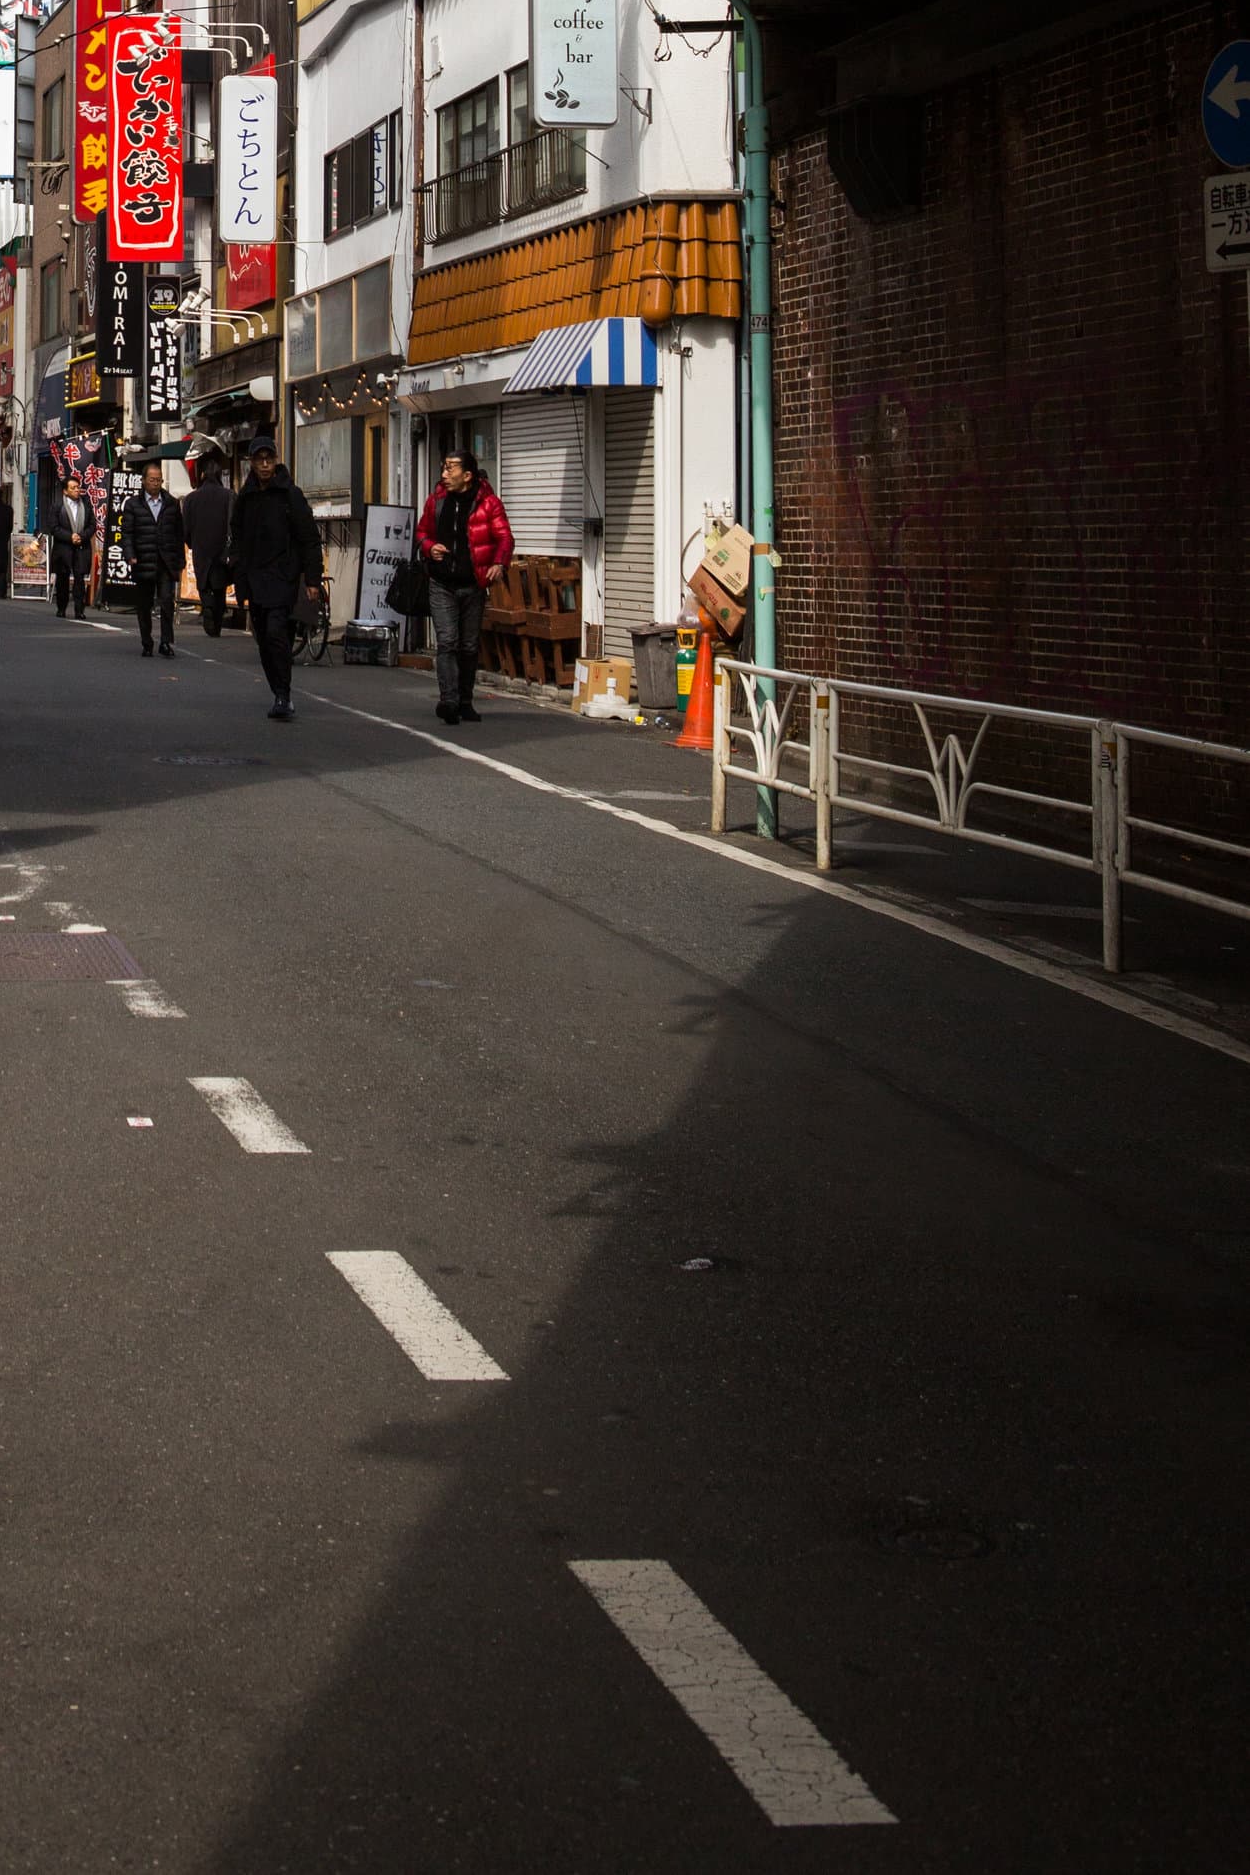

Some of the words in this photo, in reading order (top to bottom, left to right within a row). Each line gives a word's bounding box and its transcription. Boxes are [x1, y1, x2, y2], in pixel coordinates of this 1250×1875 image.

[554, 8, 605, 30] coffee
[566, 42, 594, 64] bar
[234, 93, 264, 227] ごちとん
[1211, 184, 1250, 211] 自転車
